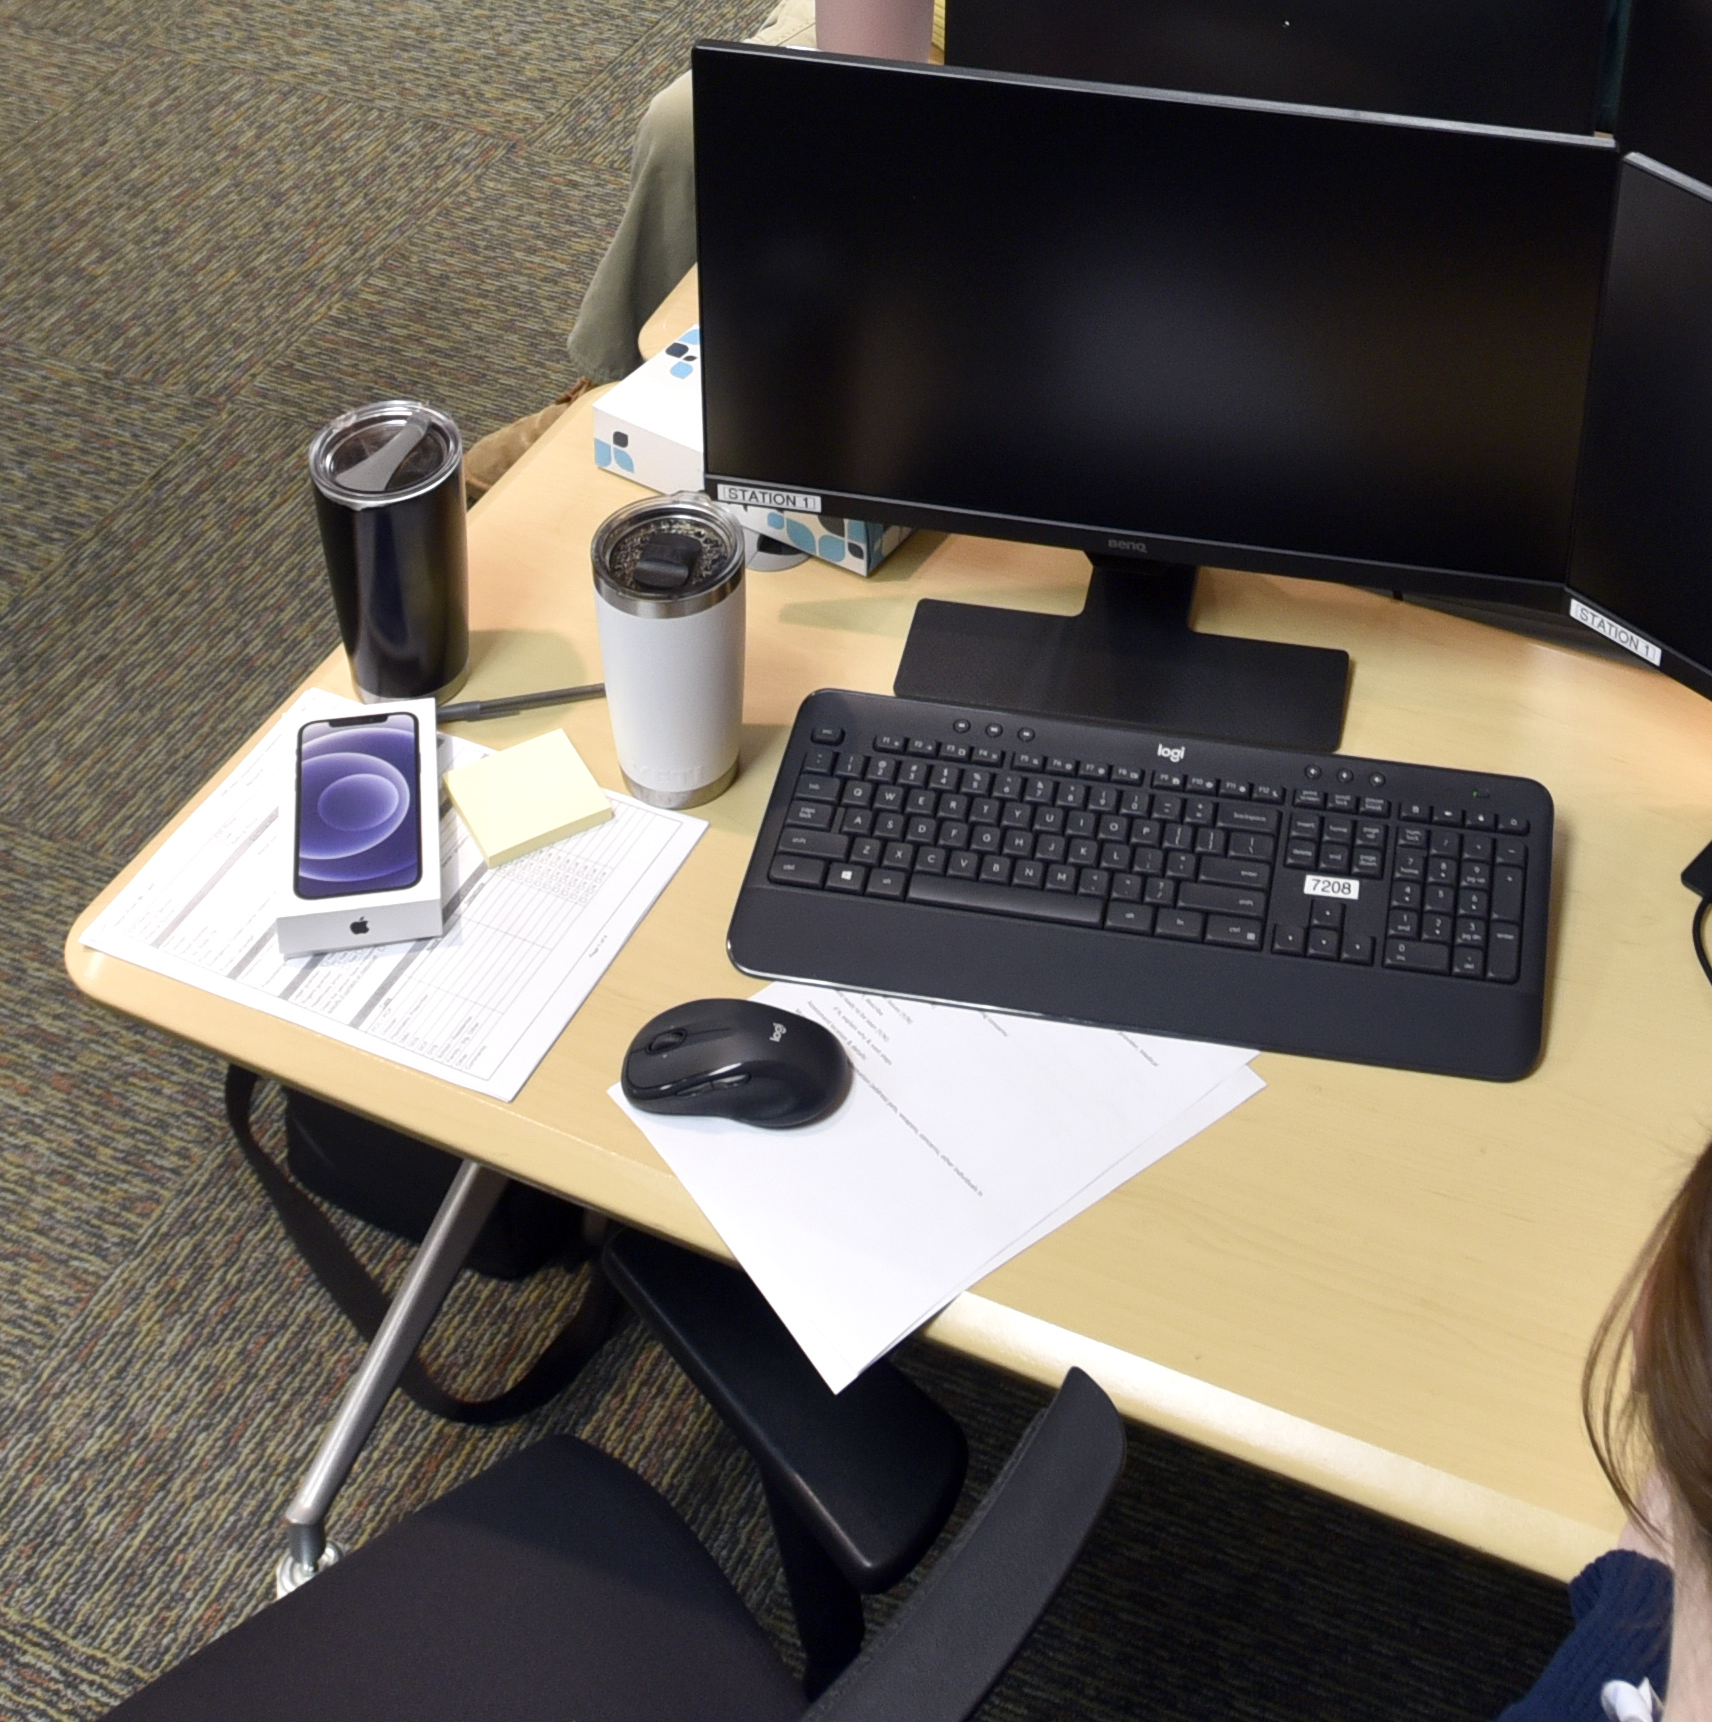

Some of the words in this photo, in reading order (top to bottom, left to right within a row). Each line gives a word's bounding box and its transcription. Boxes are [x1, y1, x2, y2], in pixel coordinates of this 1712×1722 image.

[728, 487, 797, 508] STATION
[802, 497, 810, 509] 1
[1108, 539, 1148, 554] BenQ
[1578, 606, 1640, 653] STATION
[1643, 643, 1650, 657] 1
[1156, 743, 1187, 764] logi
[854, 788, 862, 796] Q
[918, 796, 924, 805] E
[950, 801, 956, 809] R
[984, 805, 988, 813] T
[1046, 814, 1054, 822] U
[1110, 822, 1118, 831] O
[854, 816, 862, 824] A
[887, 820, 893, 828] S
[918, 824, 926, 833] D
[982, 834, 991, 842] G
[1015, 838, 1024, 846] H
[1049, 843, 1055, 851] J
[1113, 852, 1118, 860] L
[863, 845, 870, 854] Z
[927, 854, 936, 863] C
[961, 859, 968, 867] V
[992, 864, 1000, 872] B
[1025, 868, 1033, 876] N
[1311, 877, 1353, 895] 7208
[769, 1021, 787, 1043] logi
